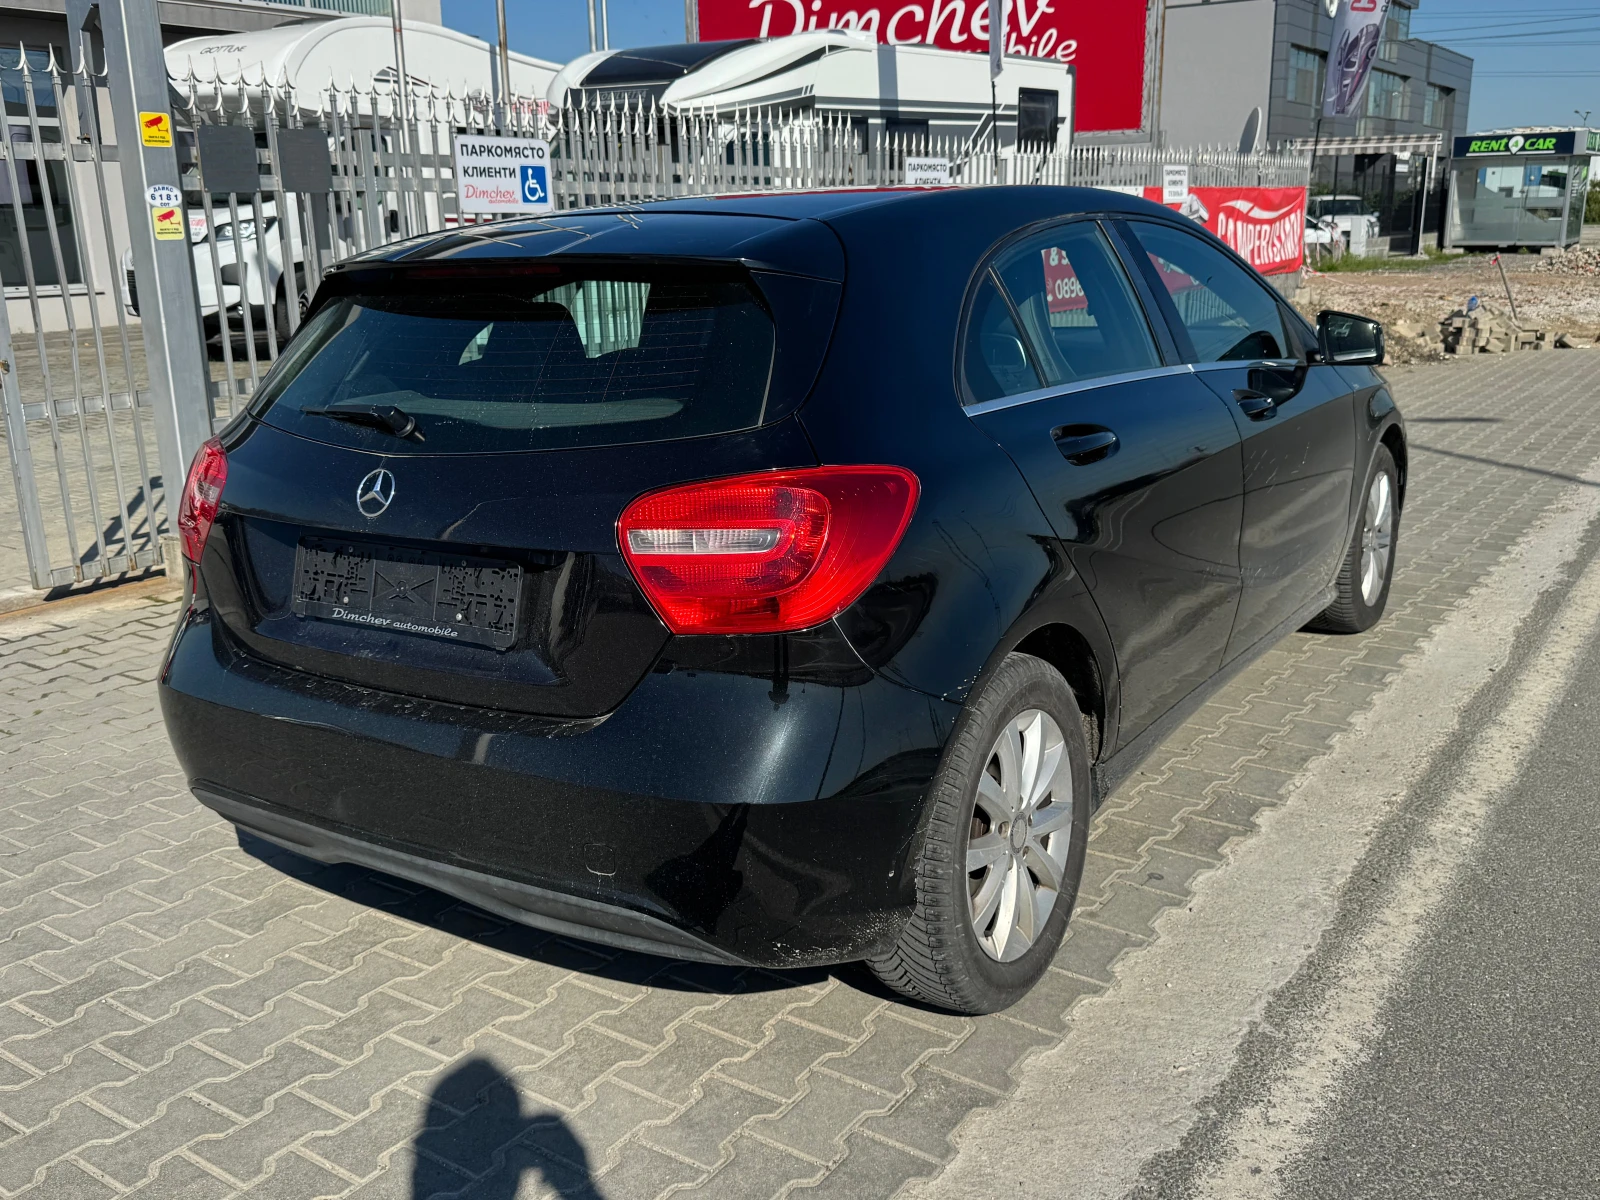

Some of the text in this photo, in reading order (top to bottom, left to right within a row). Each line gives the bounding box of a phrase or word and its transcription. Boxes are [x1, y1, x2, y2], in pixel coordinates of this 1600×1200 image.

[460, 144, 545, 159] ПАРКОМЯСТО
[1469, 137, 1508, 152] RENT
[1525, 137, 1557, 150] CAR
[463, 166, 516, 178] КЛИЕНТИ
[908, 163, 947, 172] ПАРКОМЯСТО
[151, 193, 178, 201] 6181
[464, 184, 515, 199] Dimchev
[332, 607, 459, 638] Dimchev automobile
